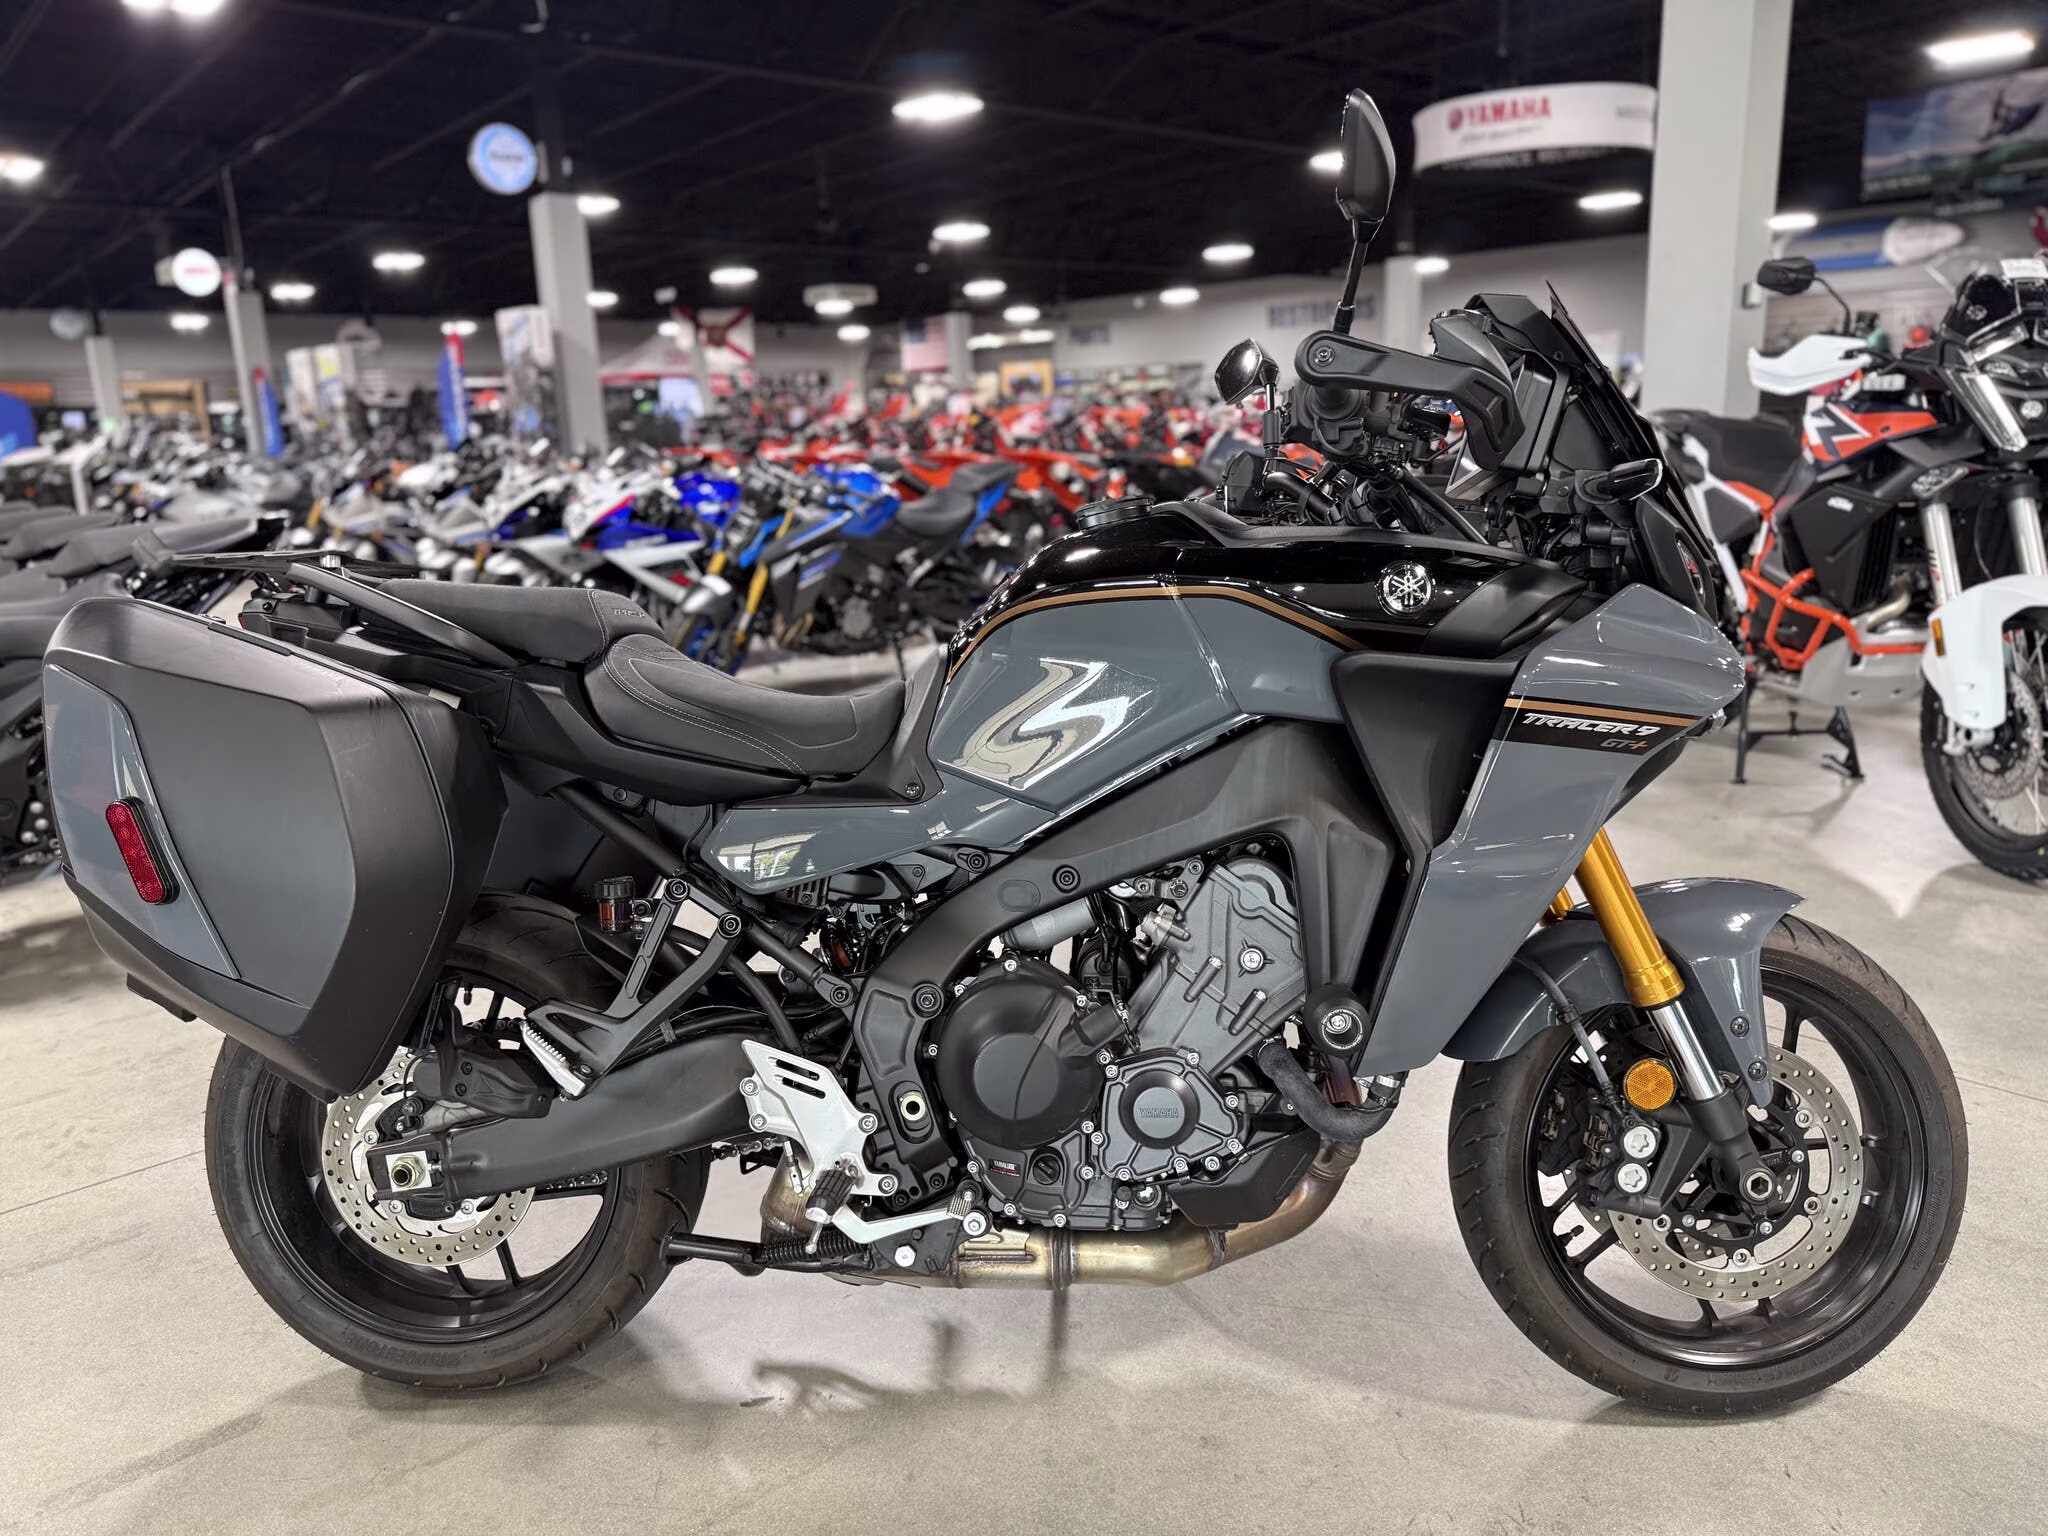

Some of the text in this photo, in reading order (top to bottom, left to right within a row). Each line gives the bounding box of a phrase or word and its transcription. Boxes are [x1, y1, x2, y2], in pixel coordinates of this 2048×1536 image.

[1466, 95, 1552, 126] YAMAHA
[1522, 712, 1640, 735] TRACER
[1600, 738, 1649, 750] GT+
[1139, 1107, 1179, 1119] YAMAHA
